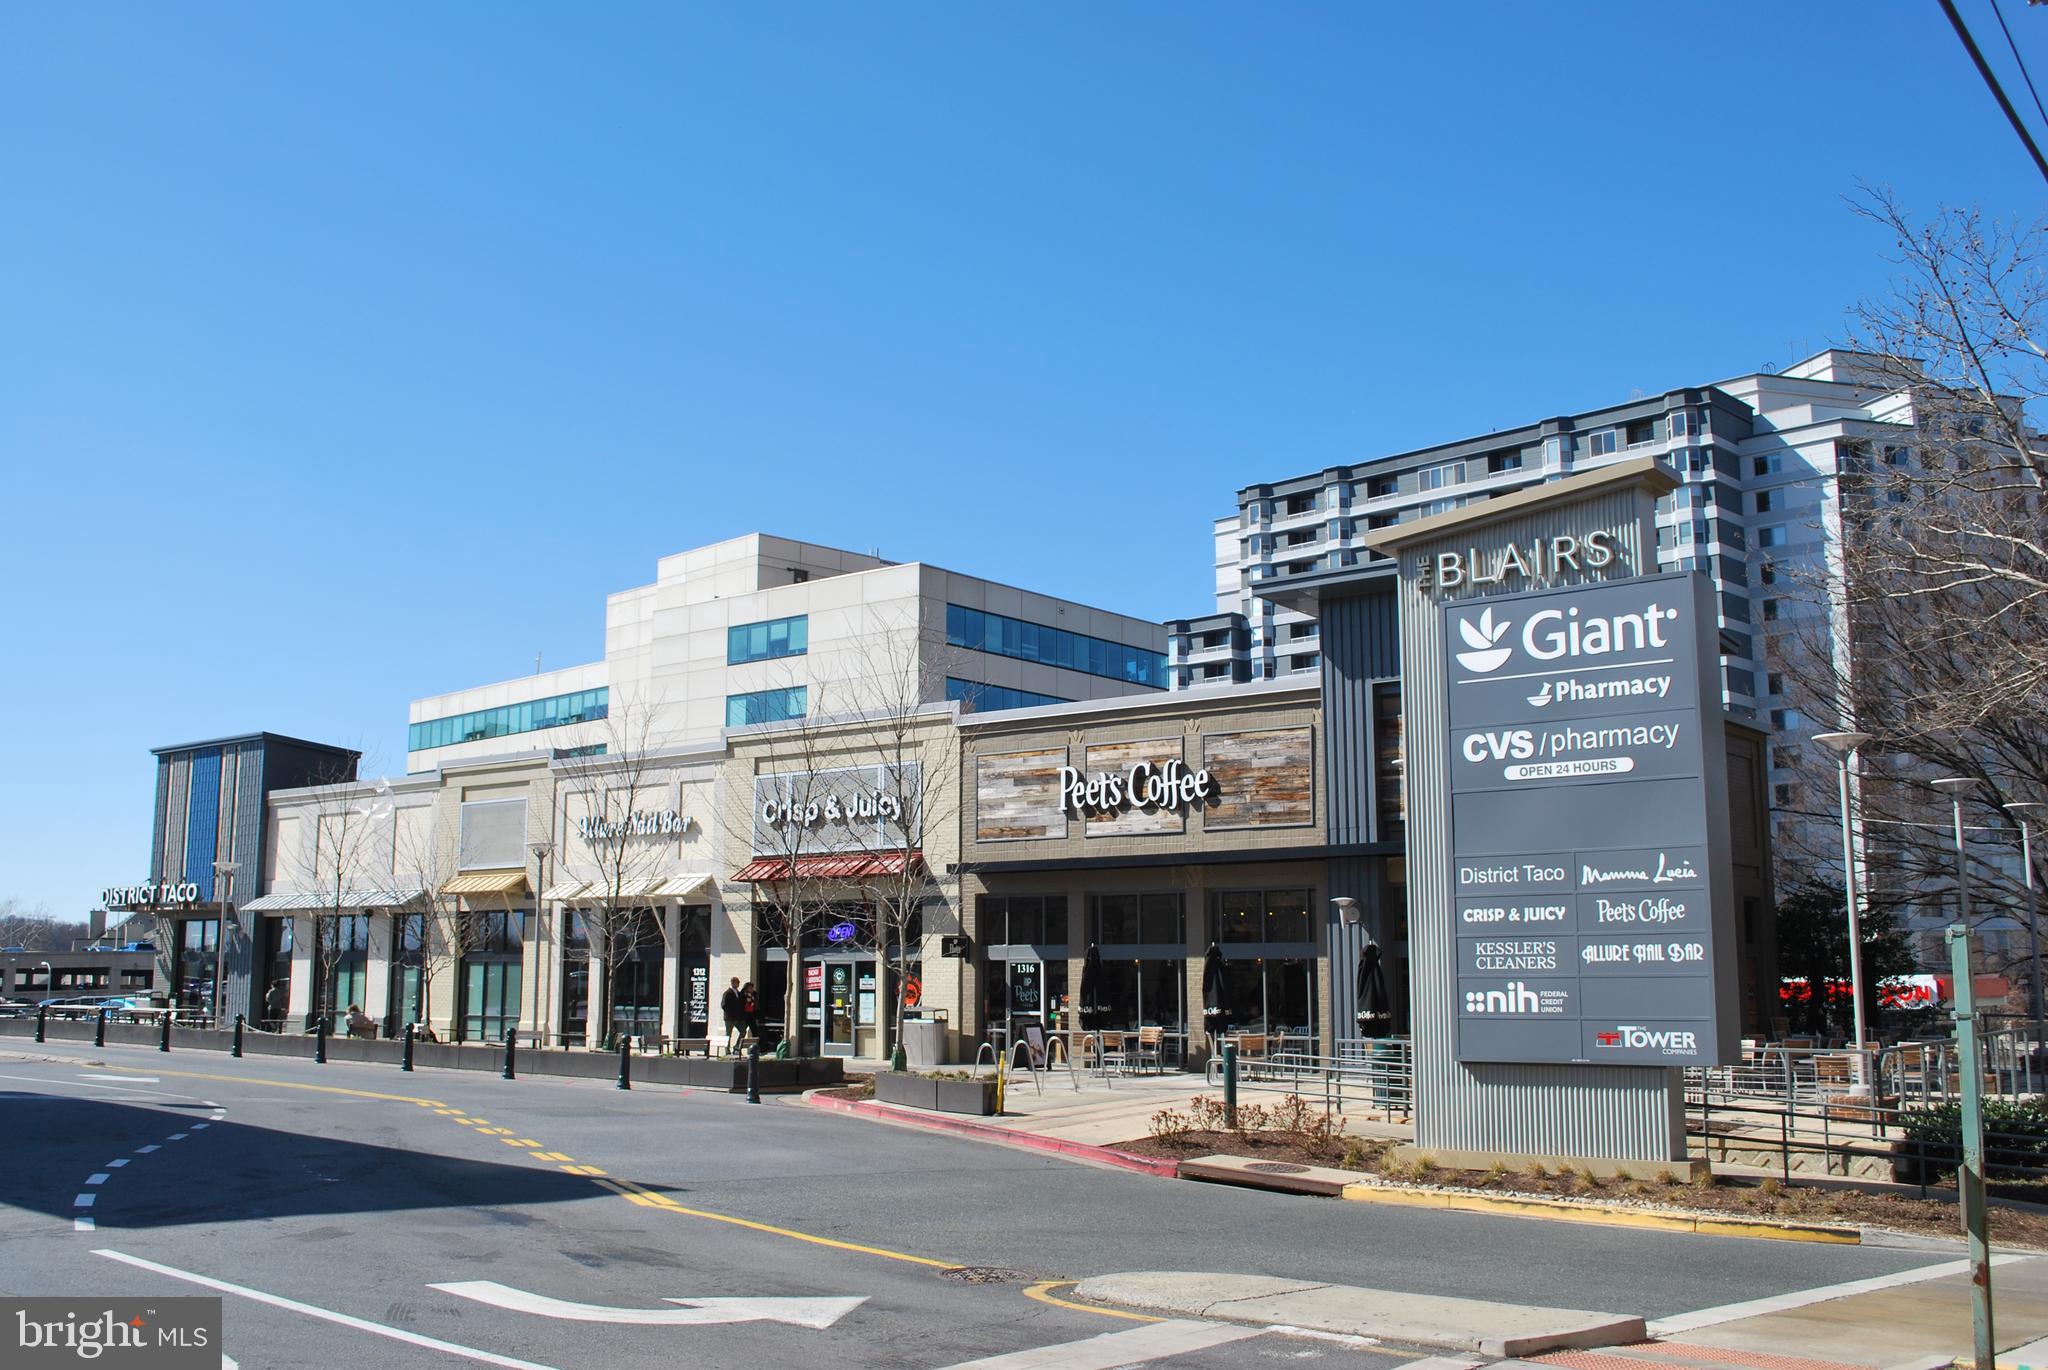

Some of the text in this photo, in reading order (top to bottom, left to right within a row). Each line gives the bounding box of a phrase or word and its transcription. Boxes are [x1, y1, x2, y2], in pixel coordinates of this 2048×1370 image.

[1438, 530, 1615, 587] BLAIRS
[1522, 603, 1668, 660] Giant
[1556, 675, 1671, 702] Pharmacy
[1519, 760, 1617, 778] OPEN 24 HOURS
[1056, 758, 1209, 811] Peet's Coffee
[762, 790, 902, 827] Crisp & Juicy
[577, 809, 693, 839] Allure Nail Bar
[1460, 865, 1565, 884] District Taco
[1581, 852, 1698, 886] Mamma Lucia
[101, 883, 198, 906] DISTRICT TACO
[1463, 906, 1566, 923] CRISP & JUICY
[1638, 898, 1686, 924] Coffee
[829, 925, 852, 939] OPEN
[1475, 942, 1556, 955] KESSLER'S
[1581, 945, 1630, 964] ALLURE
[1670, 943, 1704, 962] BAR
[693, 968, 706, 976] 1312
[1017, 964, 1035, 973] 1316
[1475, 957, 1556, 970] CLEANERS
[1486, 981, 1539, 1013] nih
[1617, 1025, 1697, 1048] TOWER
